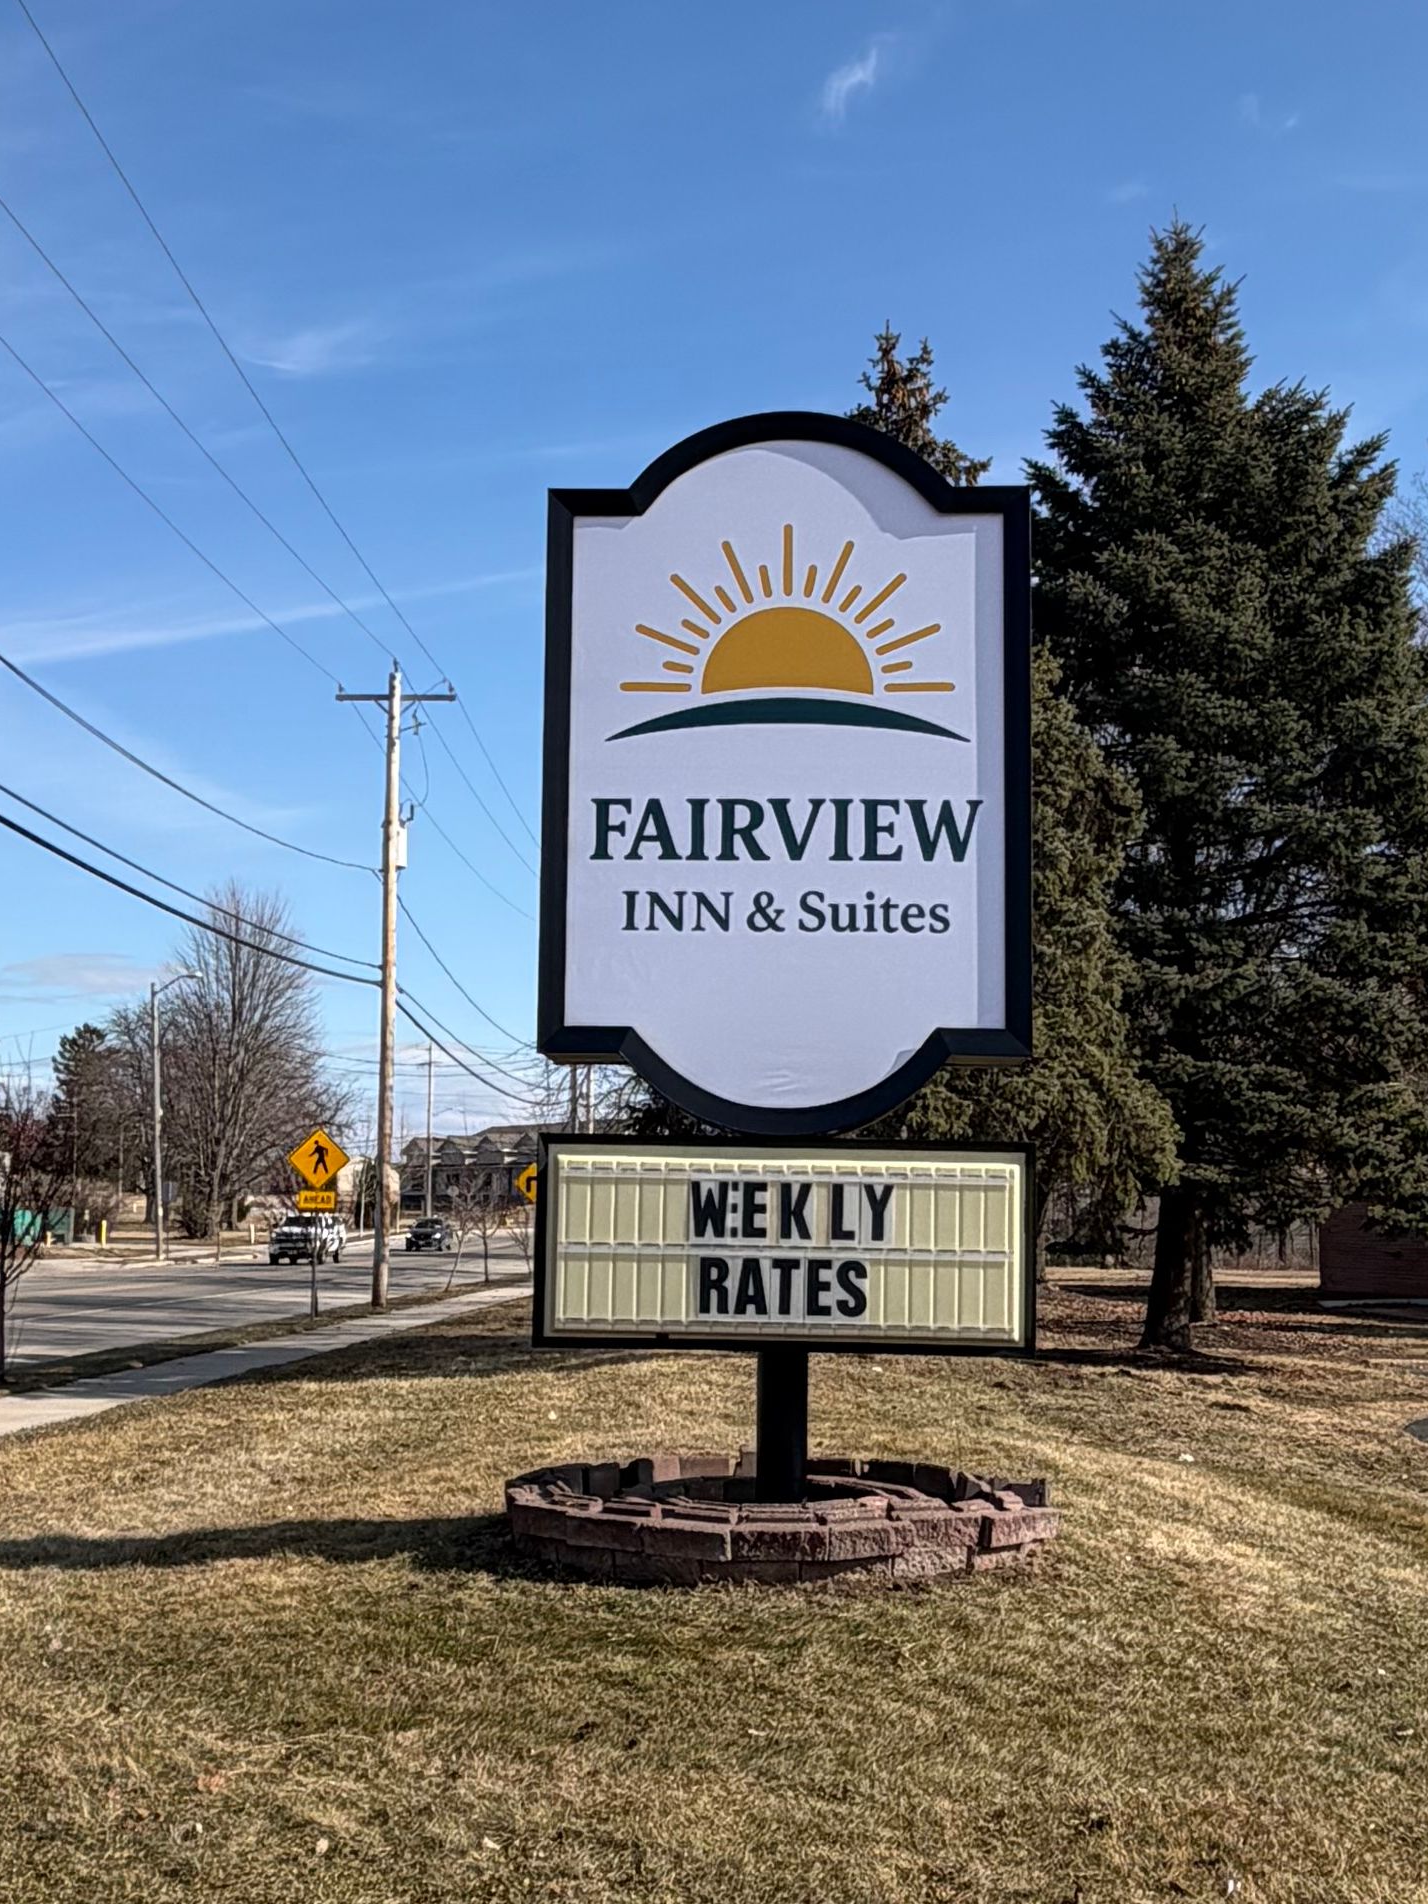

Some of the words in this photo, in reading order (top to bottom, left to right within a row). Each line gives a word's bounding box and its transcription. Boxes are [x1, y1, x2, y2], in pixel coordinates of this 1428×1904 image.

[589, 797, 984, 863] FAIRVIEW
[621, 890, 734, 933] INN
[745, 891, 786, 934] &
[797, 890, 951, 935] Suites
[303, 1194, 332, 1205] AHEAD
[698, 1256, 869, 1318] RATES
